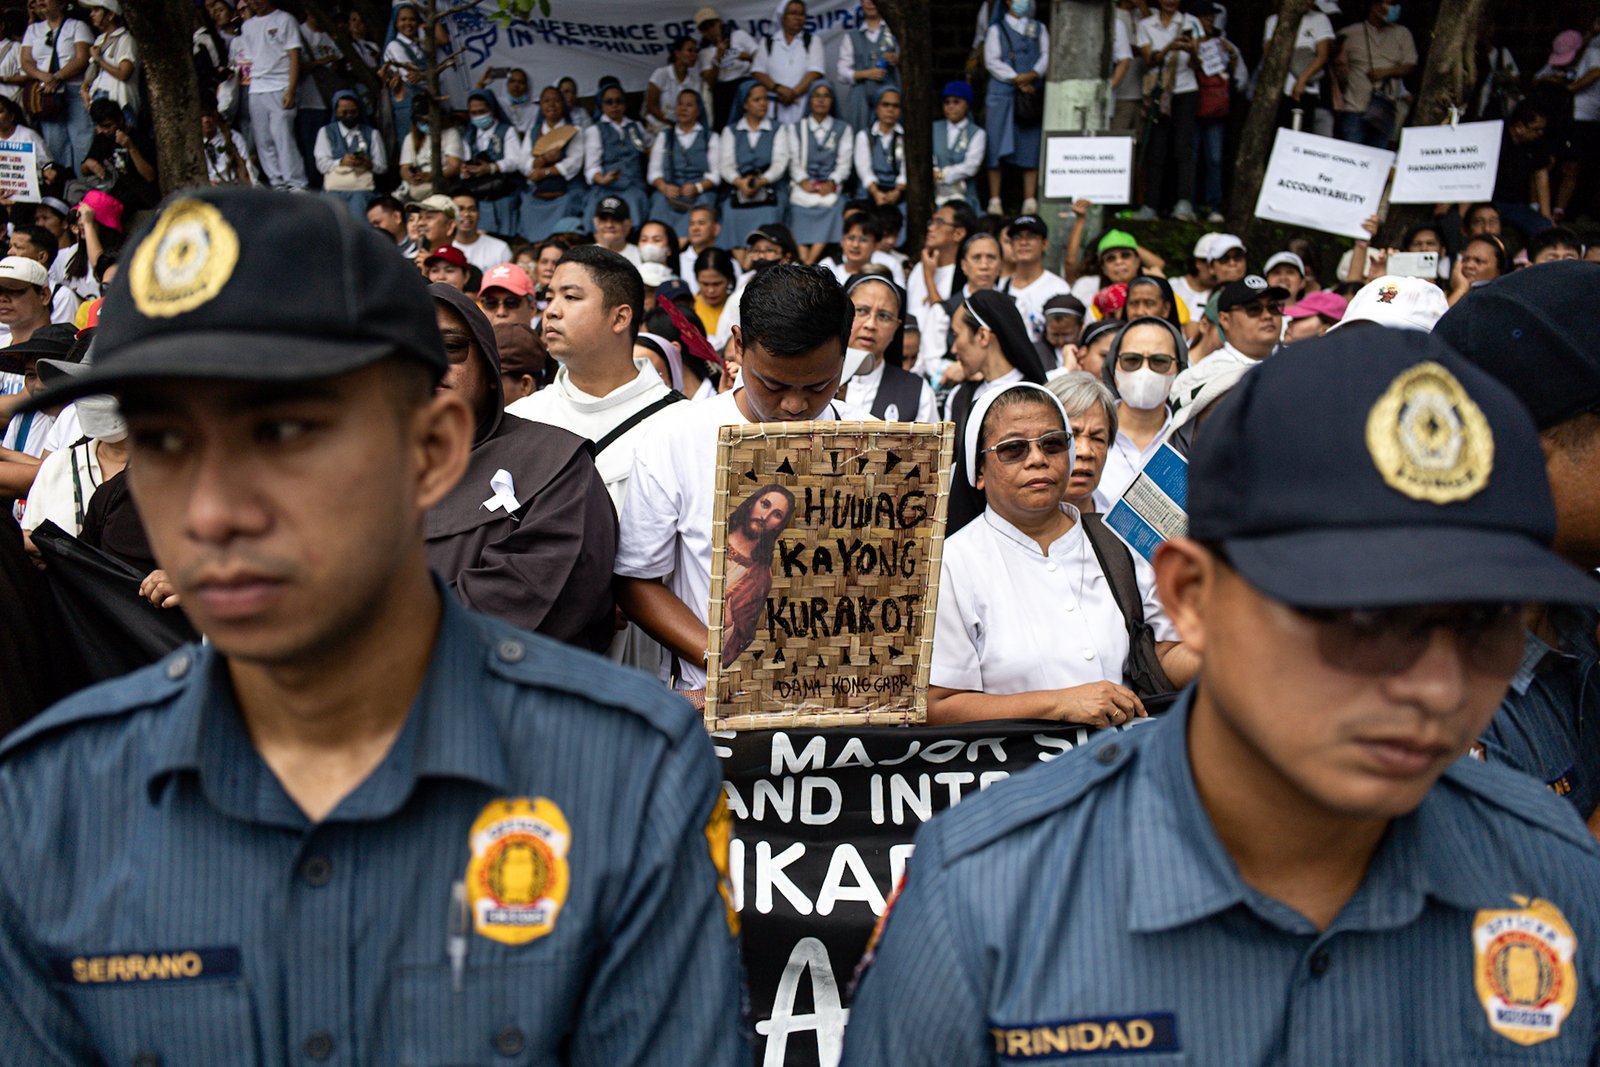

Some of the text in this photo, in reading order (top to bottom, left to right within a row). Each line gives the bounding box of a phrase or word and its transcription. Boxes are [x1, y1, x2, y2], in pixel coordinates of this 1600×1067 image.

[508, 28, 533, 48] IN
[511, 19, 659, 40] NFERENCE
[664, 20, 695, 39] OF
[1277, 178, 1367, 204] ACCOUNTABILITY
[804, 487, 929, 530] HUWAG
[777, 537, 918, 579] KAYONG
[767, 594, 924, 642] KURAKOT
[770, 731, 1008, 776] MAJOR
[721, 776, 842, 826] AND
[72, 951, 203, 984] SERRANO
[991, 1018, 1155, 1057] TRINIDAD
